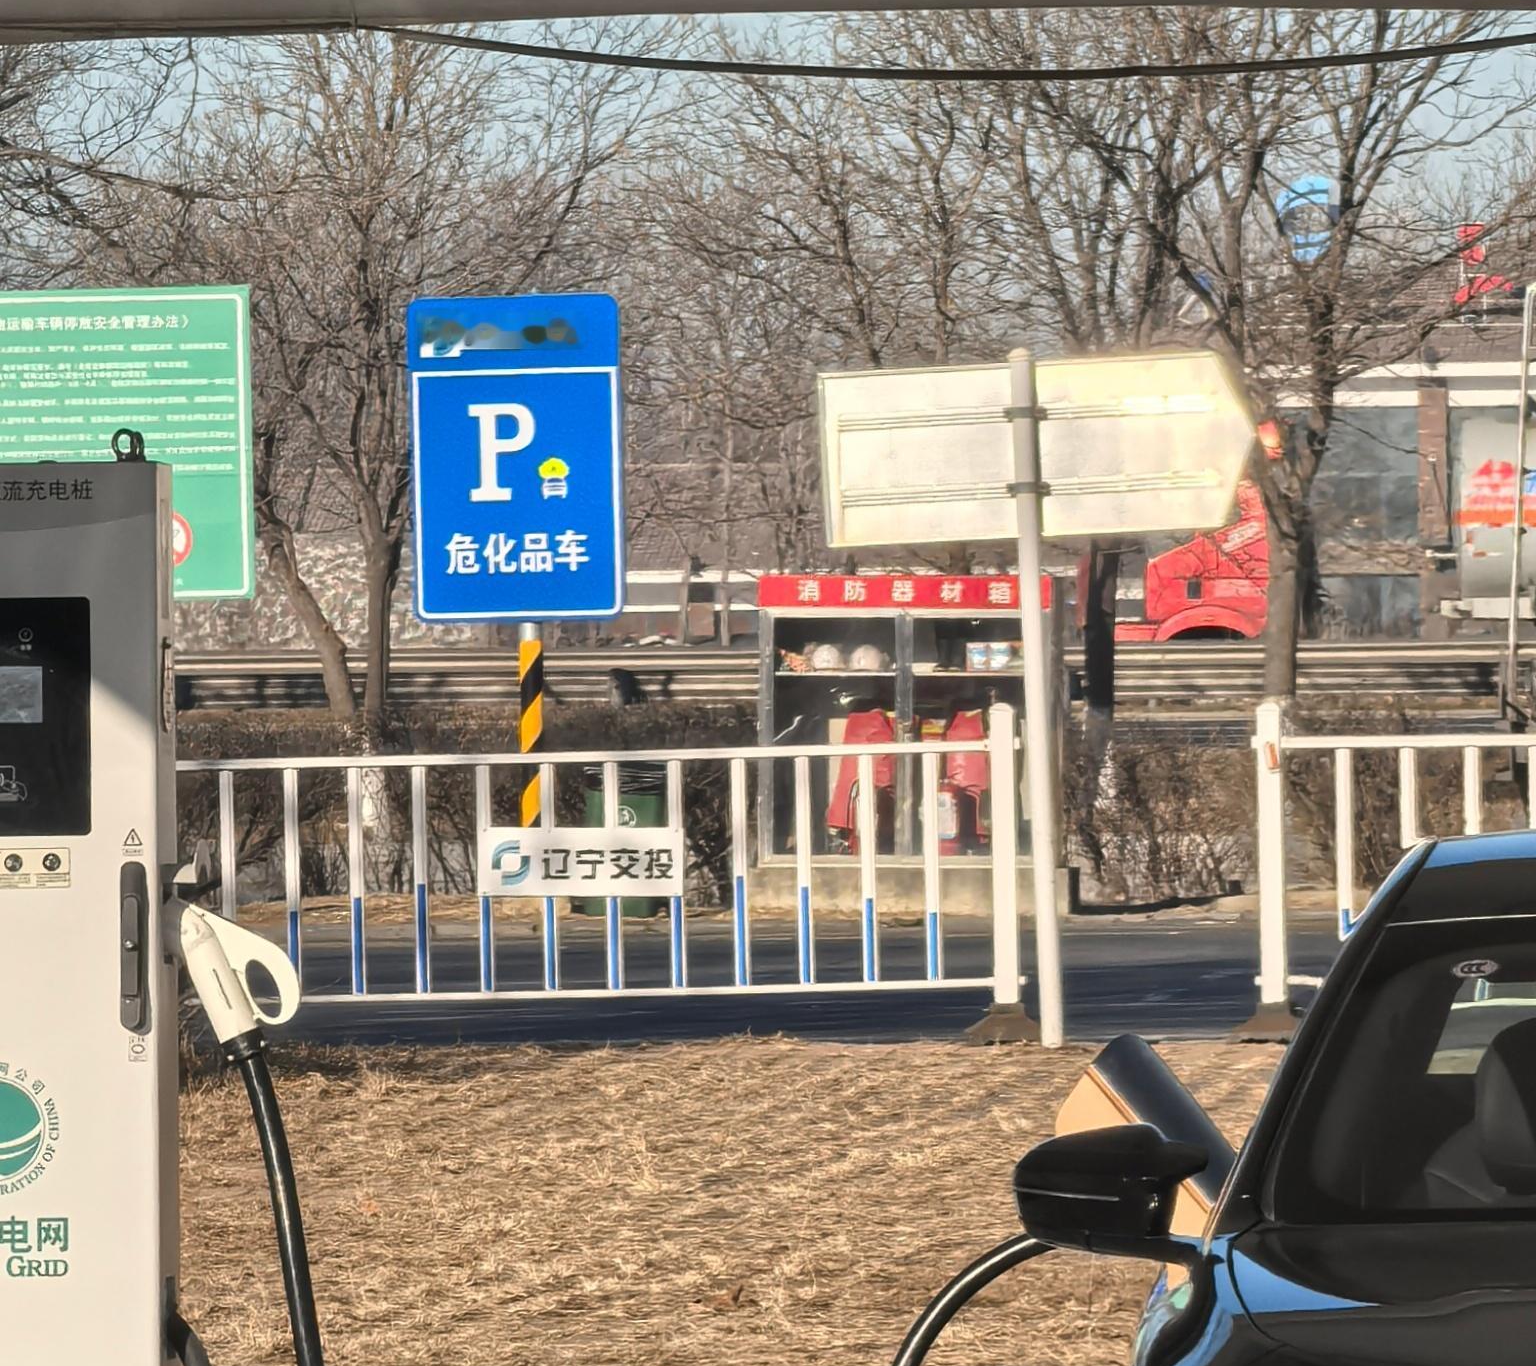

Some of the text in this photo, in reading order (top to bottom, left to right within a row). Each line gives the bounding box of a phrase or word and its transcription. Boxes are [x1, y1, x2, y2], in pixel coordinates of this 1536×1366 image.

[468, 402, 535, 502] P
[0, 478, 93, 501] 流充电桩
[444, 530, 590, 574] 危化品车
[798, 580, 1012, 604] 消防器材箱
[541, 848, 673, 880] 辽宁交投
